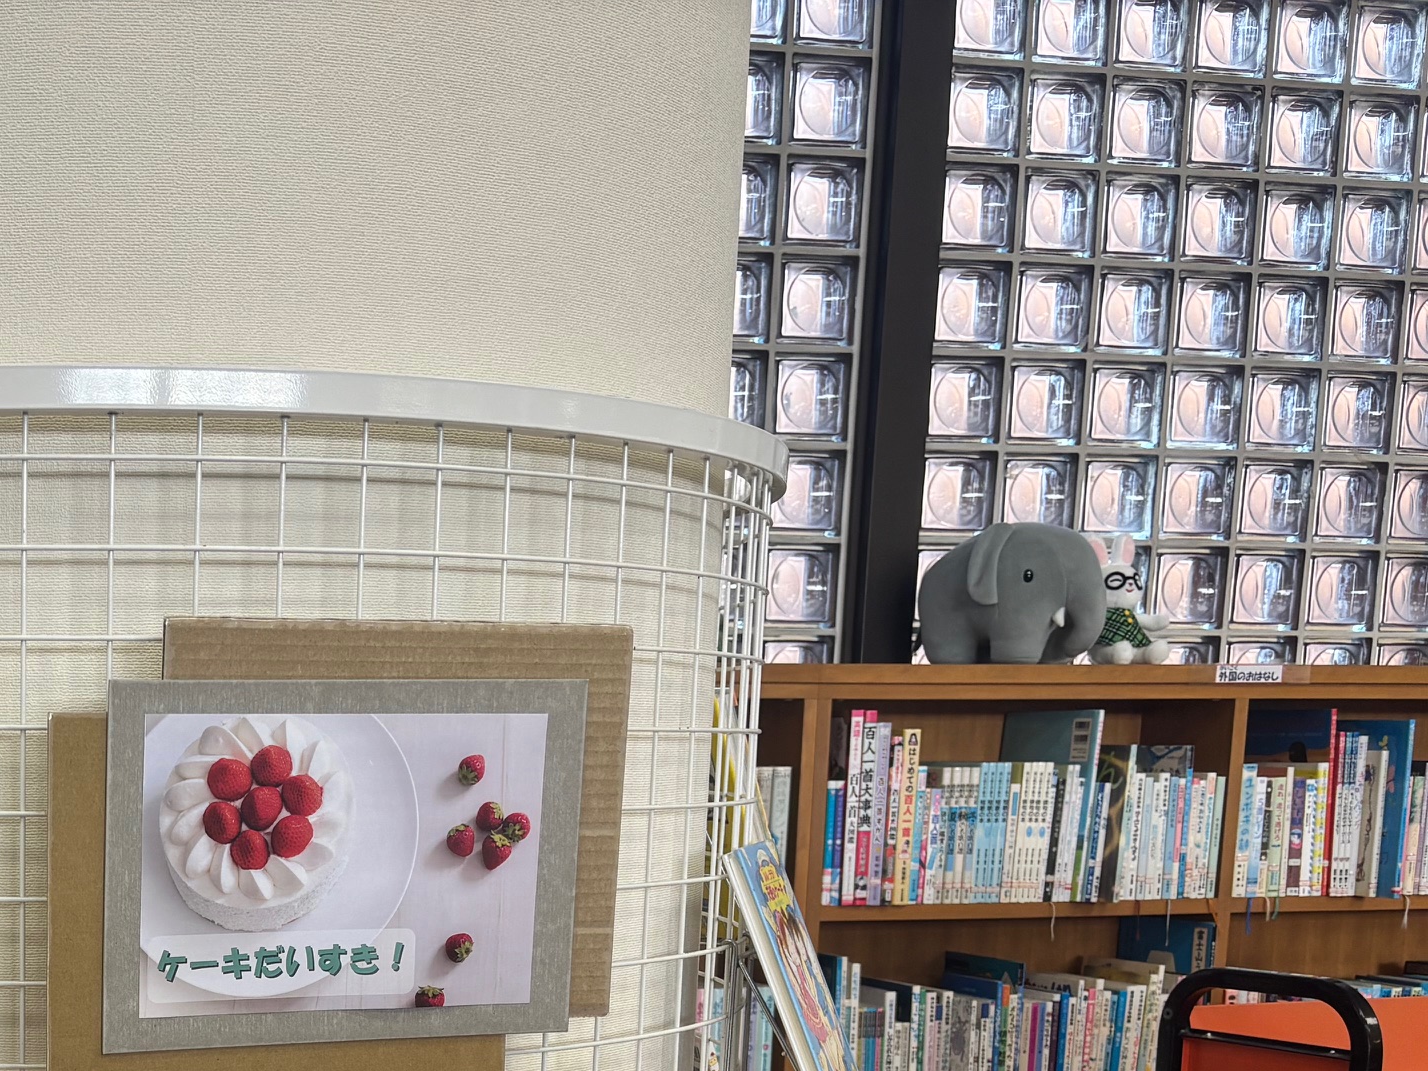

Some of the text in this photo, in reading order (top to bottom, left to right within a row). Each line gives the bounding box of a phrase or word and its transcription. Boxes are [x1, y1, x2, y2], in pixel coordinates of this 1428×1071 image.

[1218, 670, 1279, 682] 外国のおはなし
[858, 726, 878, 828] 百人一首大事典
[902, 747, 917, 838] はじめての百人一首
[156, 940, 406, 984] ケーキだいすき！
